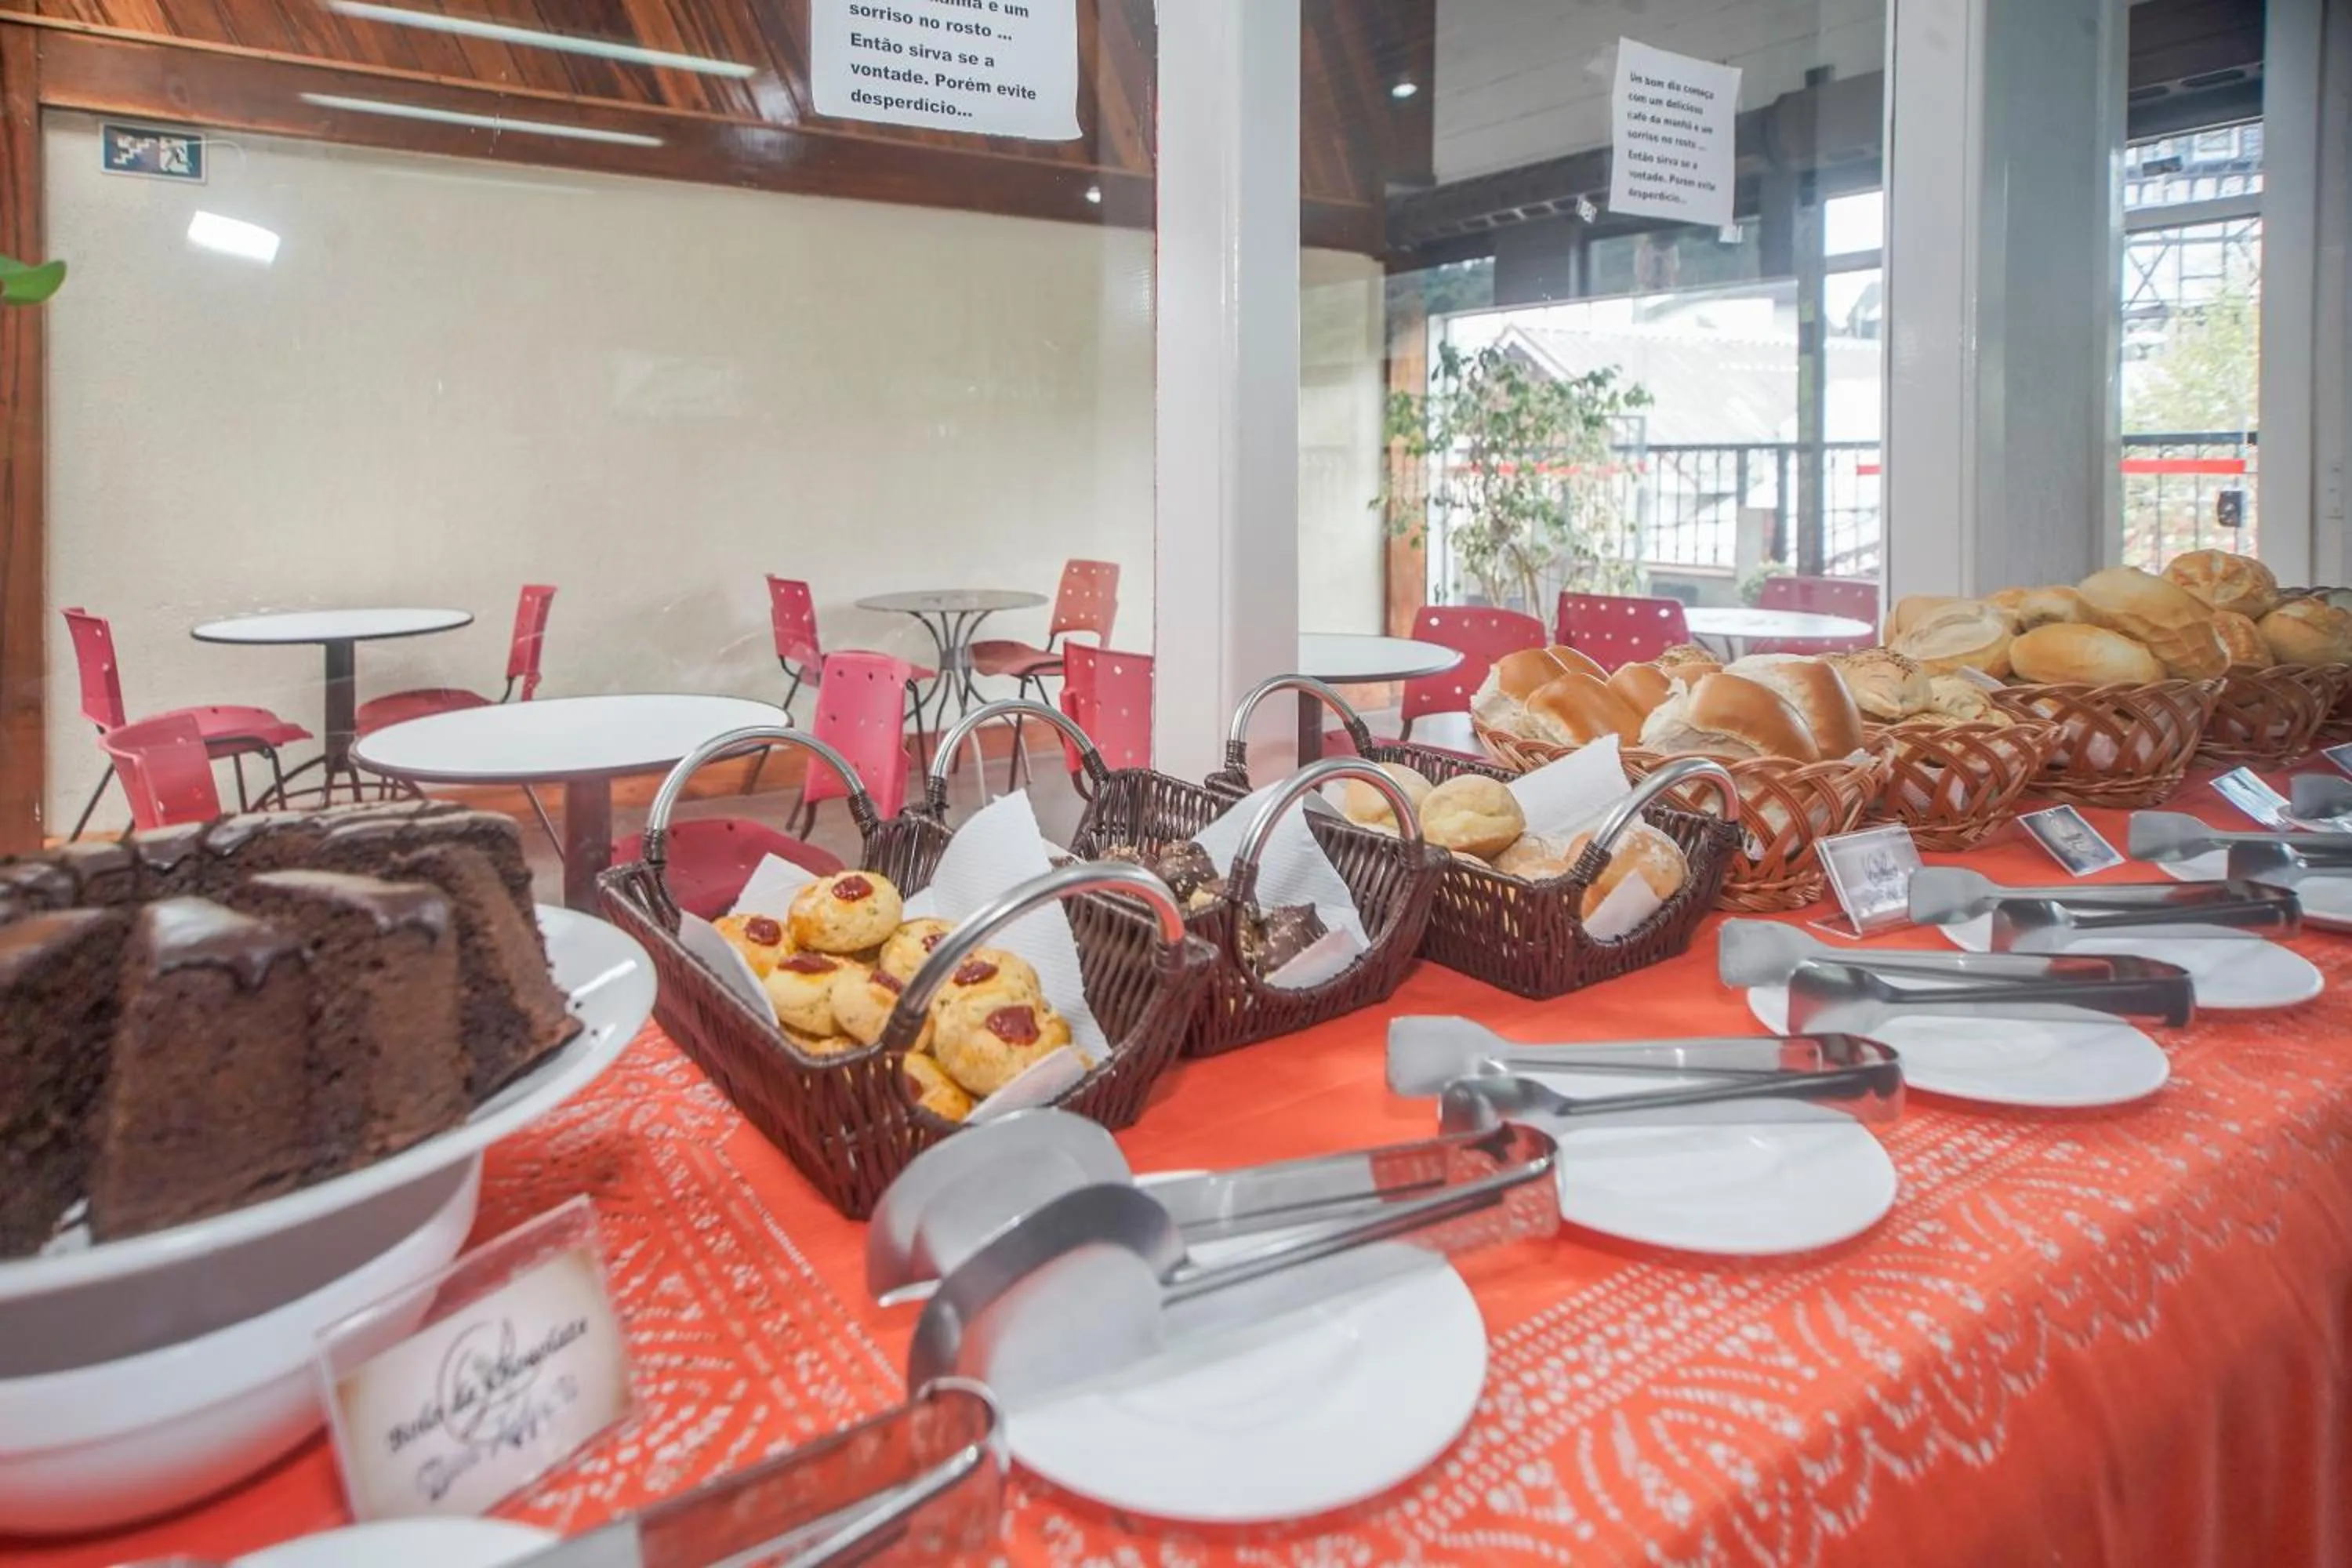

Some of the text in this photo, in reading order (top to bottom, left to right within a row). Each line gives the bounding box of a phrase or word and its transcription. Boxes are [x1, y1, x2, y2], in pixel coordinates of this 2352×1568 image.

[849, 4, 913, 24] sorriso
[919, 15, 941, 29] no
[946, 20, 993, 37] rosto
[1004, 3, 1029, 17] um
[850, 32, 995, 67] Então sirva se a
[850, 63, 1036, 100] vontade. Porém evite
